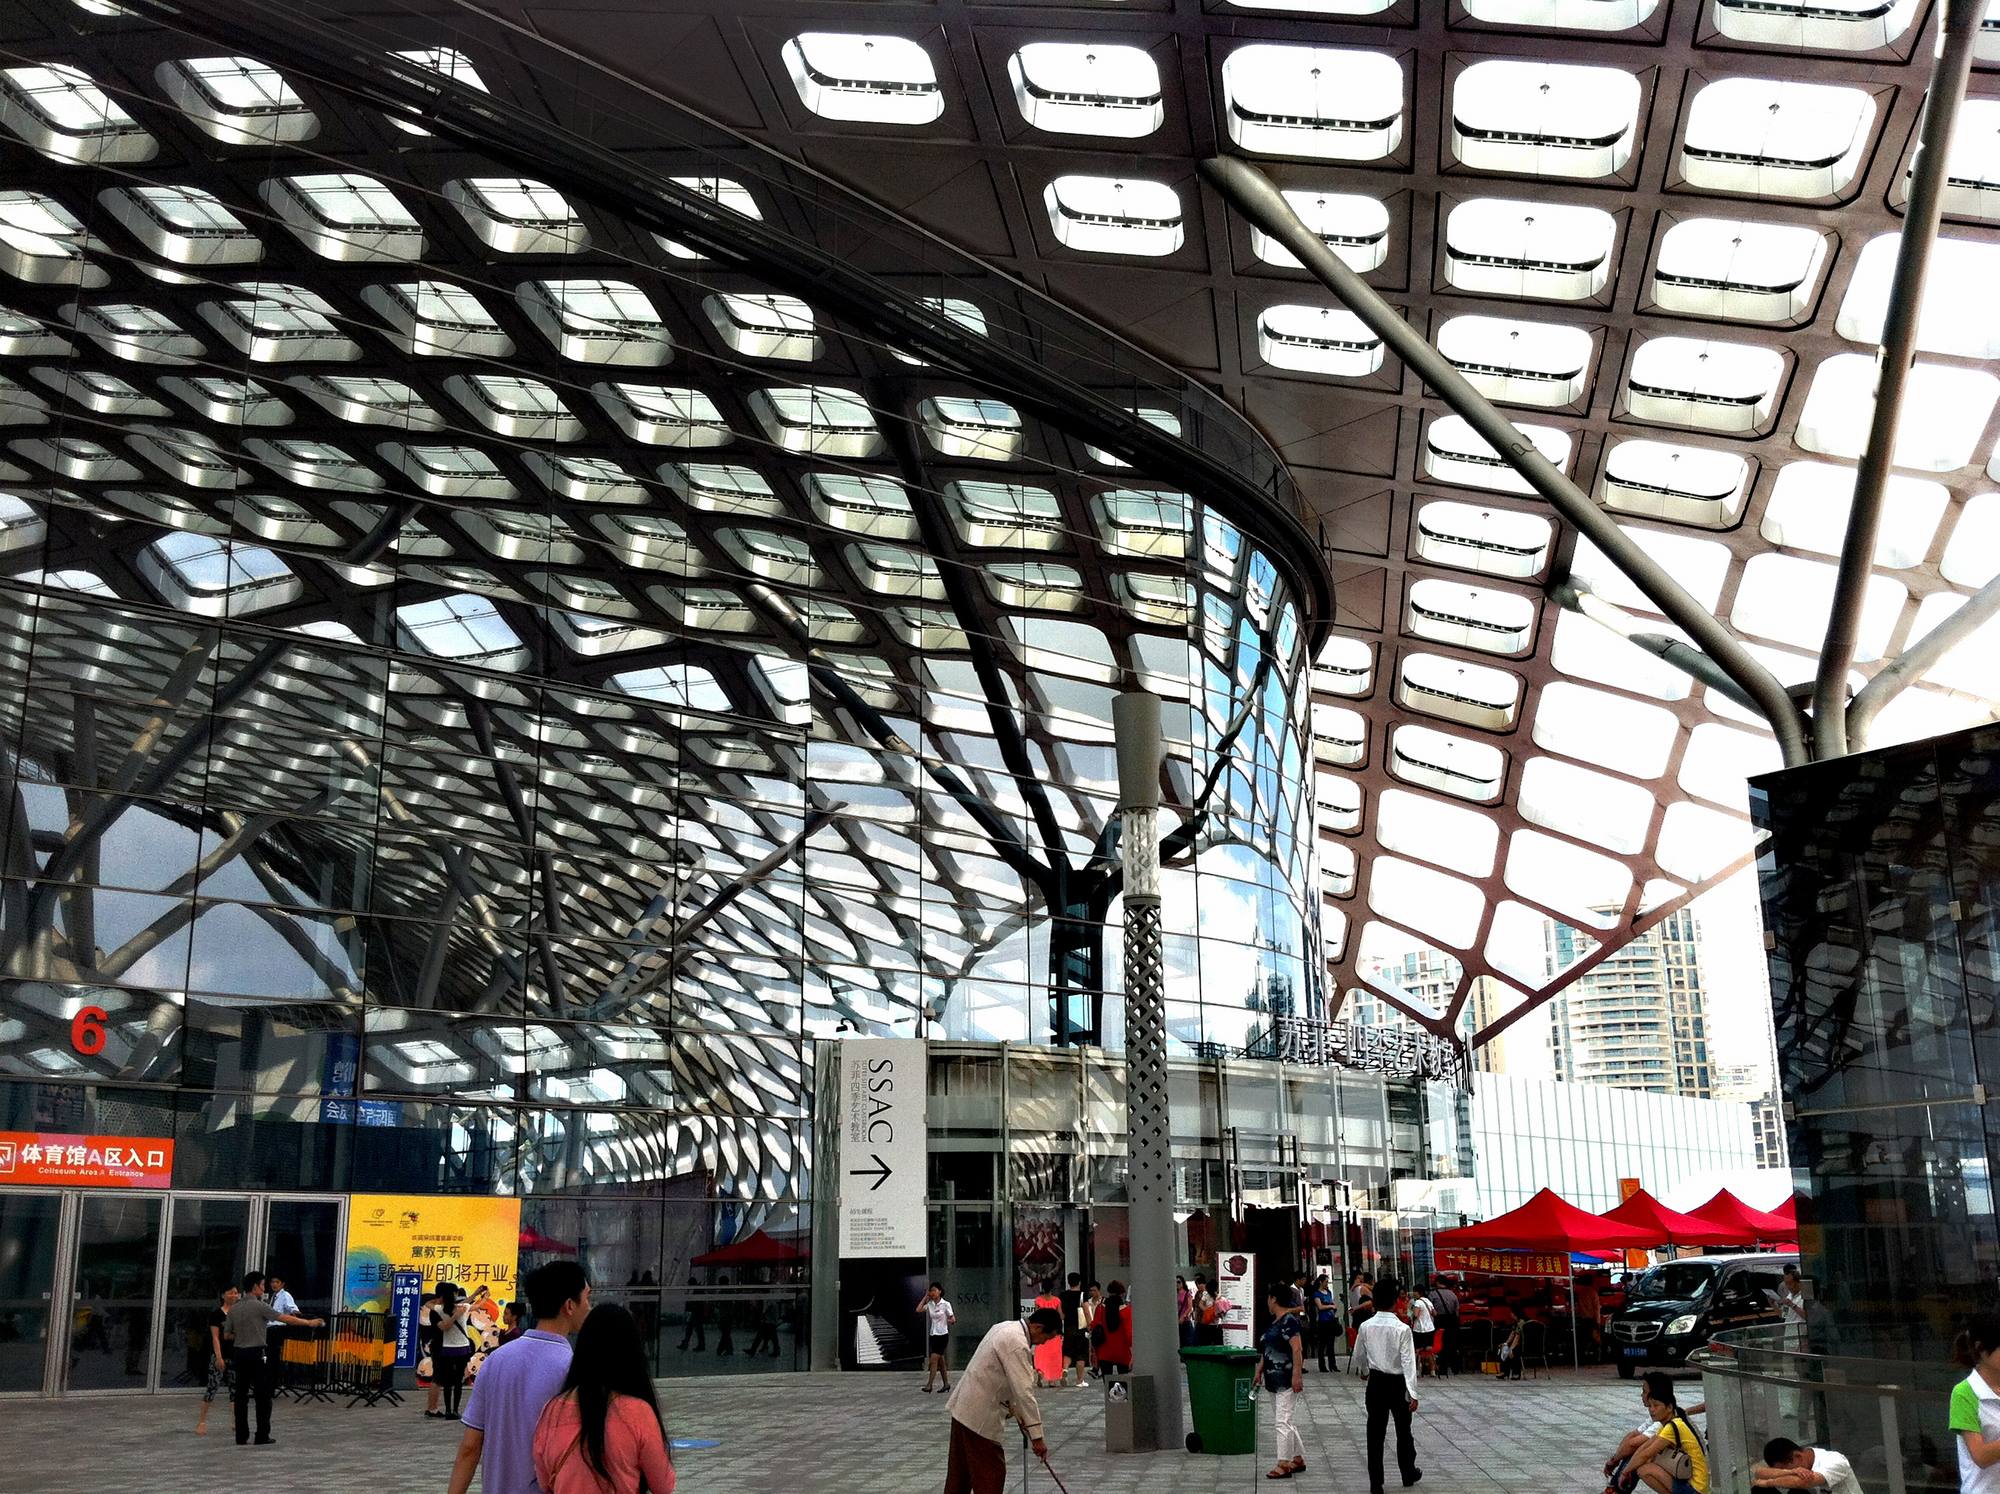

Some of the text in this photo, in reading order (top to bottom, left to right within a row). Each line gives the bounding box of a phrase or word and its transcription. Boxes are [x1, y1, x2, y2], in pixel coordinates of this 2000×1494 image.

[71, 1005, 109, 1055] 6
[868, 1058, 893, 1143] SSAC
[21, 1144, 164, 1168] 体育馆A区入口
[38, 1167, 77, 1176] Coliseum
[79, 1168, 98, 1177] Area
[109, 1169, 145, 1179] Entrance
[395, 1286, 418, 1296] 体育场
[397, 1296, 411, 1360] 内设有洗手间
